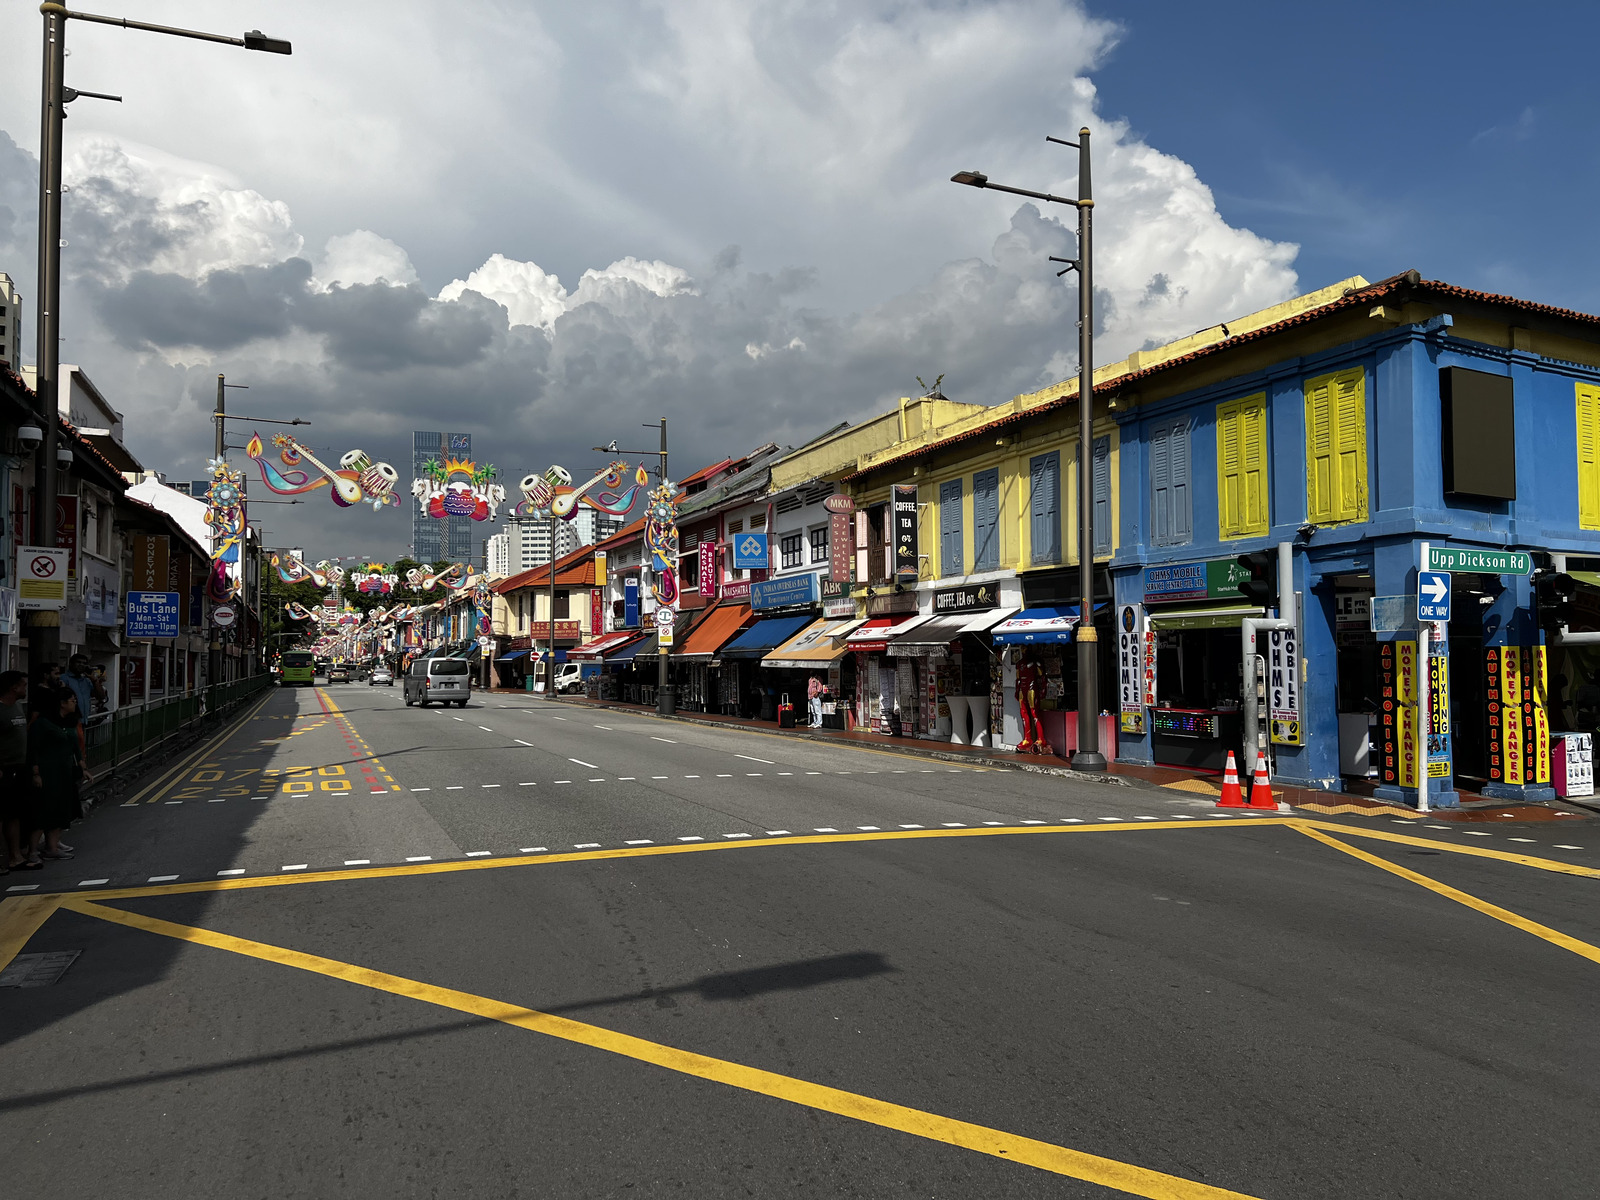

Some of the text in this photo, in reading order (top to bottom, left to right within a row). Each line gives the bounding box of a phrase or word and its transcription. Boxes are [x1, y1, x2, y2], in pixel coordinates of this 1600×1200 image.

[830, 499, 851, 509] MKM
[895, 501, 917, 513] COFFEE,
[901, 518, 912, 528] TEA
[833, 515, 841, 566] COSTUME
[901, 535, 912, 543] or
[840, 523, 849, 581] JEWELLERY
[1431, 550, 1524, 569] Upp Dickson Rd
[146, 536, 156, 589] MONEYMAX
[1149, 566, 1201, 581] OHMS MOBILE
[723, 584, 748, 597] NAKSHATRA
[763, 579, 809, 593] INDIAN OVERSEAS BANK
[1146, 582, 1164, 591] SERVICE
[1165, 580, 1183, 590] CENTRE
[1194, 579, 1206, 588] LTD.
[768, 592, 805, 604] Remittance Centre
[956, 592, 966, 606] TEA
[966, 596, 976, 605] or
[1336, 597, 1352, 614] LE
[128, 602, 177, 614] Bus Lane
[1420, 605, 1448, 617] ONE WAY
[1003, 619, 1033, 627] NETS
[1250, 634, 1255, 643] 6
[1121, 634, 1130, 702] OHMS
[1130, 634, 1139, 702] MOBILE
[1145, 632, 1154, 704] REPAIR
[1271, 630, 1283, 708] OHMS
[1284, 630, 1295, 708] MOBILE
[1431, 657, 1438, 666] &
[1431, 670, 1438, 689] ON
[1381, 644, 1395, 781] AUTHORISED
[1400, 645, 1414, 784] MONEY CHANGER
[1486, 649, 1501, 779] AUTHORISED
[1505, 650, 1519, 781] MONEY CHANGER
[1523, 650, 1534, 781] AUTHORISED
